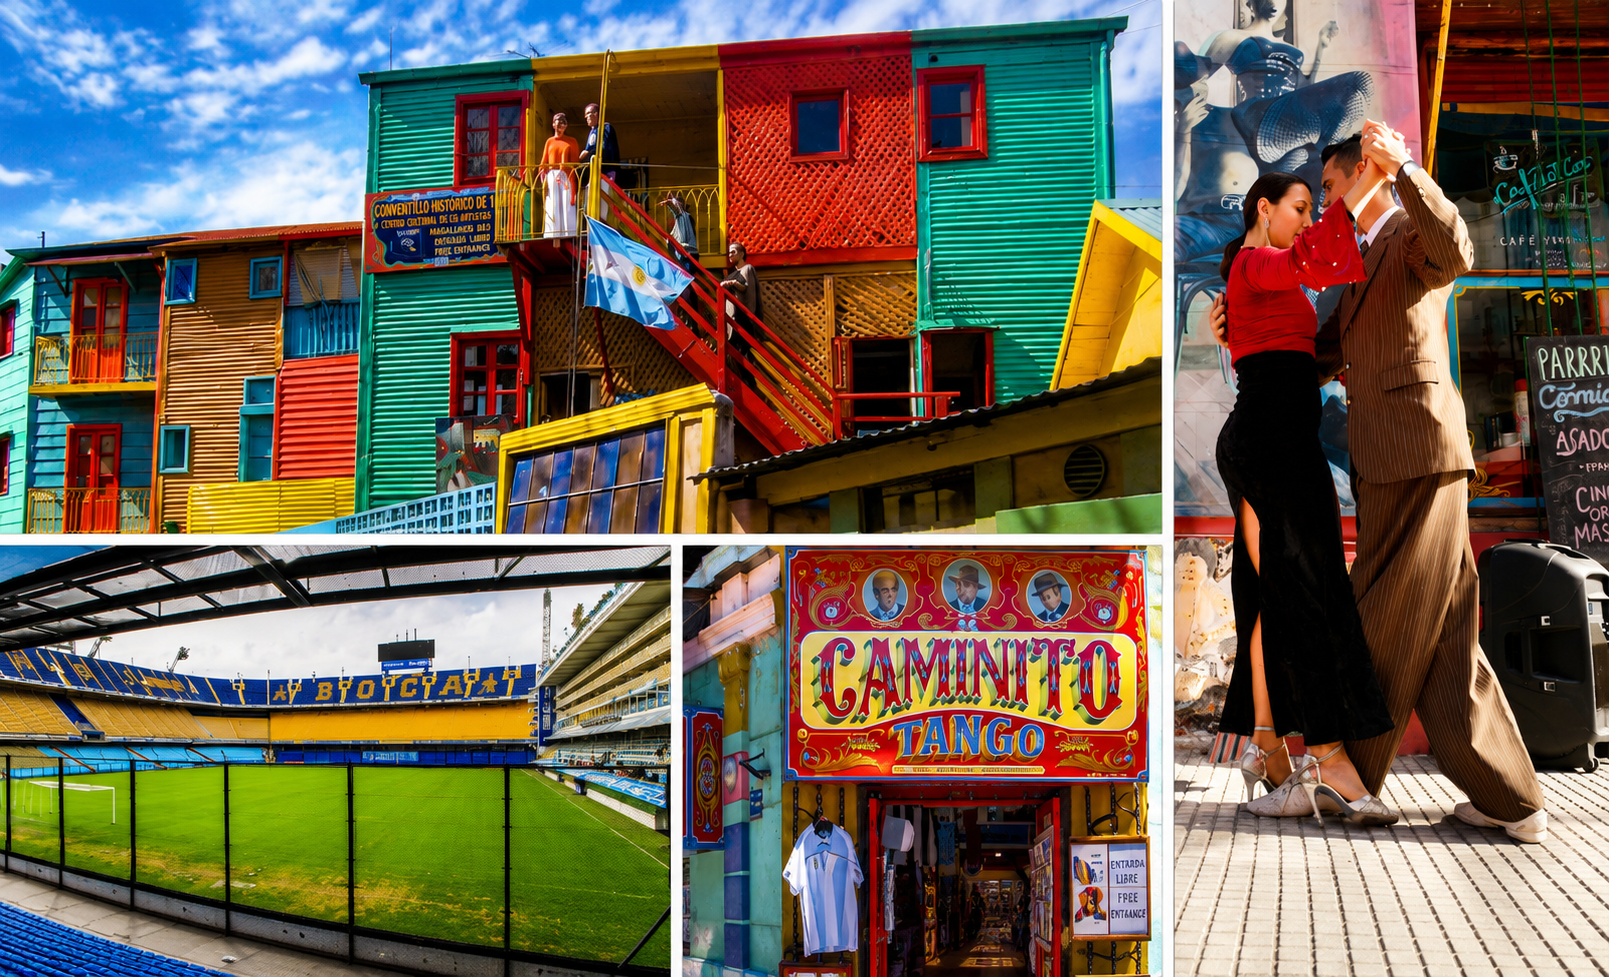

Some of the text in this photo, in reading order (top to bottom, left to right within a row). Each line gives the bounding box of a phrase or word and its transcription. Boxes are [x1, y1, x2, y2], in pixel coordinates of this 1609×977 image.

[476, 195, 487, 209] DE
[1575, 484, 1609, 513] CIN
[811, 636, 1124, 726] CAMINITO
[892, 714, 1046, 763] TANGO
[1115, 873, 1138, 885] LIBRE
